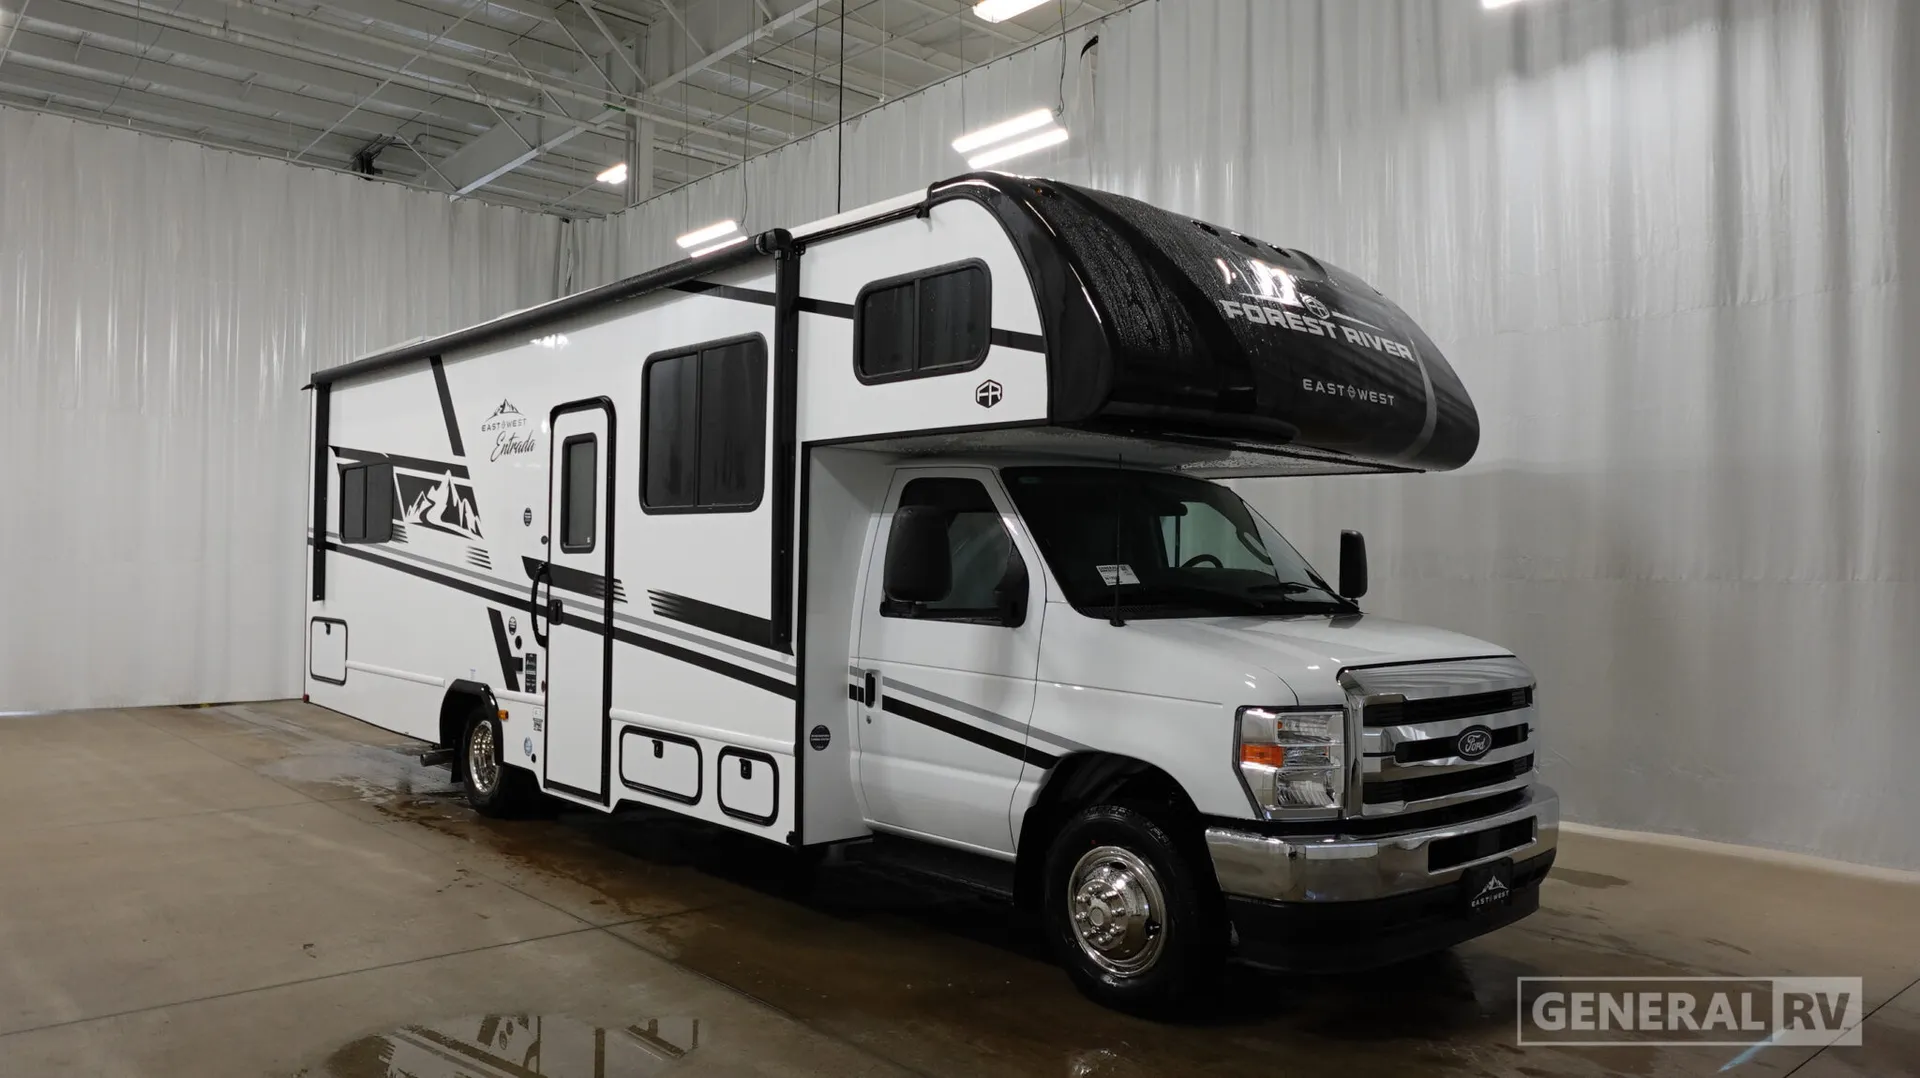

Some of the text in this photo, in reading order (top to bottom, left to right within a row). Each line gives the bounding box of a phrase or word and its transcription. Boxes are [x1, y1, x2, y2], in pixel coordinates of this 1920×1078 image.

[1219, 299, 1415, 362] FOREST RIVER
[1303, 378, 1395, 406] EAST WEST
[481, 418, 527, 432] EAST WEST
[490, 430, 536, 462] Entrada
[1465, 734, 1486, 752] Ford
